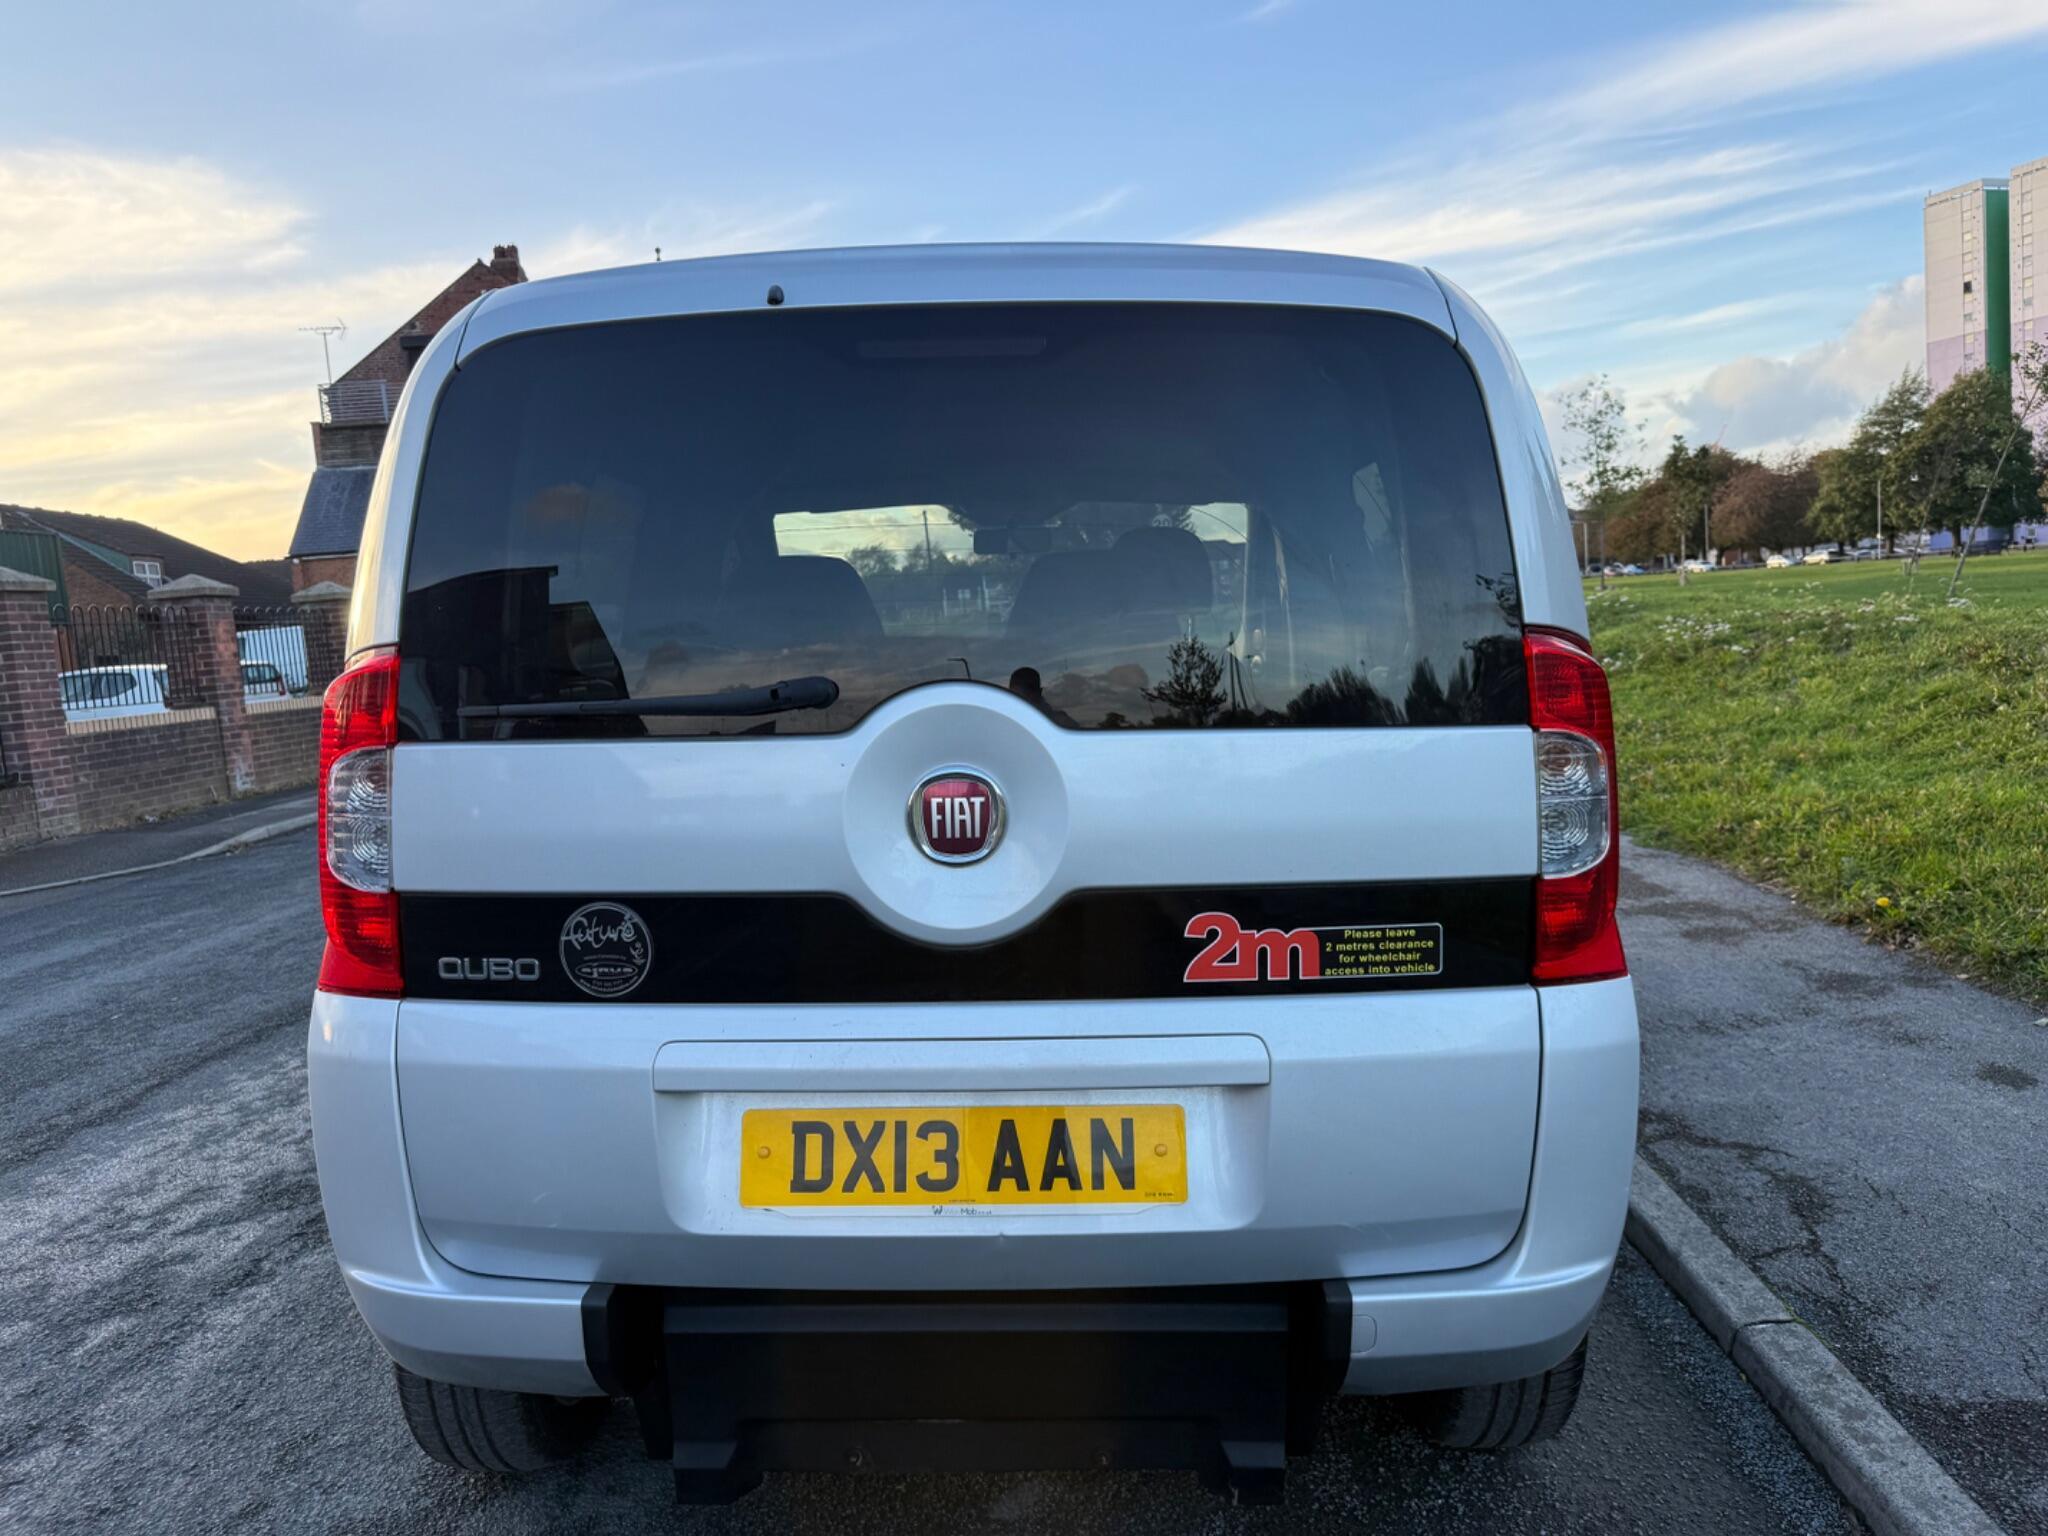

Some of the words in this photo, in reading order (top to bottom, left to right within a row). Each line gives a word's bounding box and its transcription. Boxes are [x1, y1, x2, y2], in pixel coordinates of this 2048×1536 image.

[930, 796, 986, 840] FIAT
[1344, 929, 1383, 939] Please
[1386, 928, 1417, 937] leave
[1183, 912, 1321, 982] 2m
[1325, 942, 1332, 952] 2
[1336, 942, 1375, 951] metres
[1379, 940, 1434, 950] clearance
[1339, 954, 1355, 963] for
[1358, 951, 1421, 962] wheelchair
[438, 957, 540, 981] QUBO
[1325, 967, 1365, 976] access
[1368, 965, 1391, 974] into
[1394, 962, 1436, 973] vehicle
[789, 1120, 960, 1194] DX13
[986, 1117, 1136, 1192] AAN
